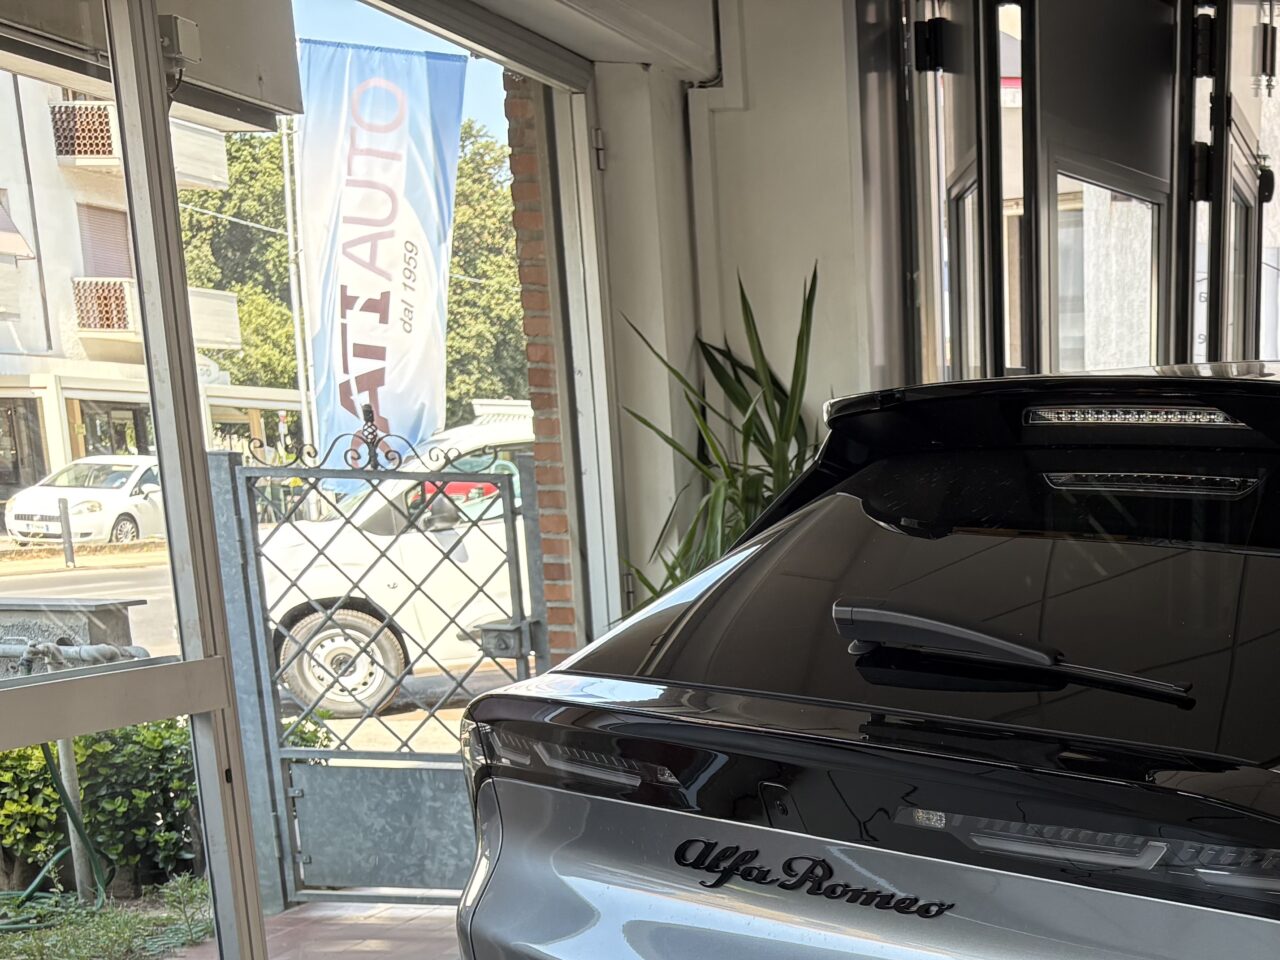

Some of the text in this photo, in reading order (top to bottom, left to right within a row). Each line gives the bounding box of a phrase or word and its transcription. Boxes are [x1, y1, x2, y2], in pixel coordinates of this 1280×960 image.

[402, 240, 420, 335] dal 1959
[674, 838, 955, 919] Alfa Romeo
